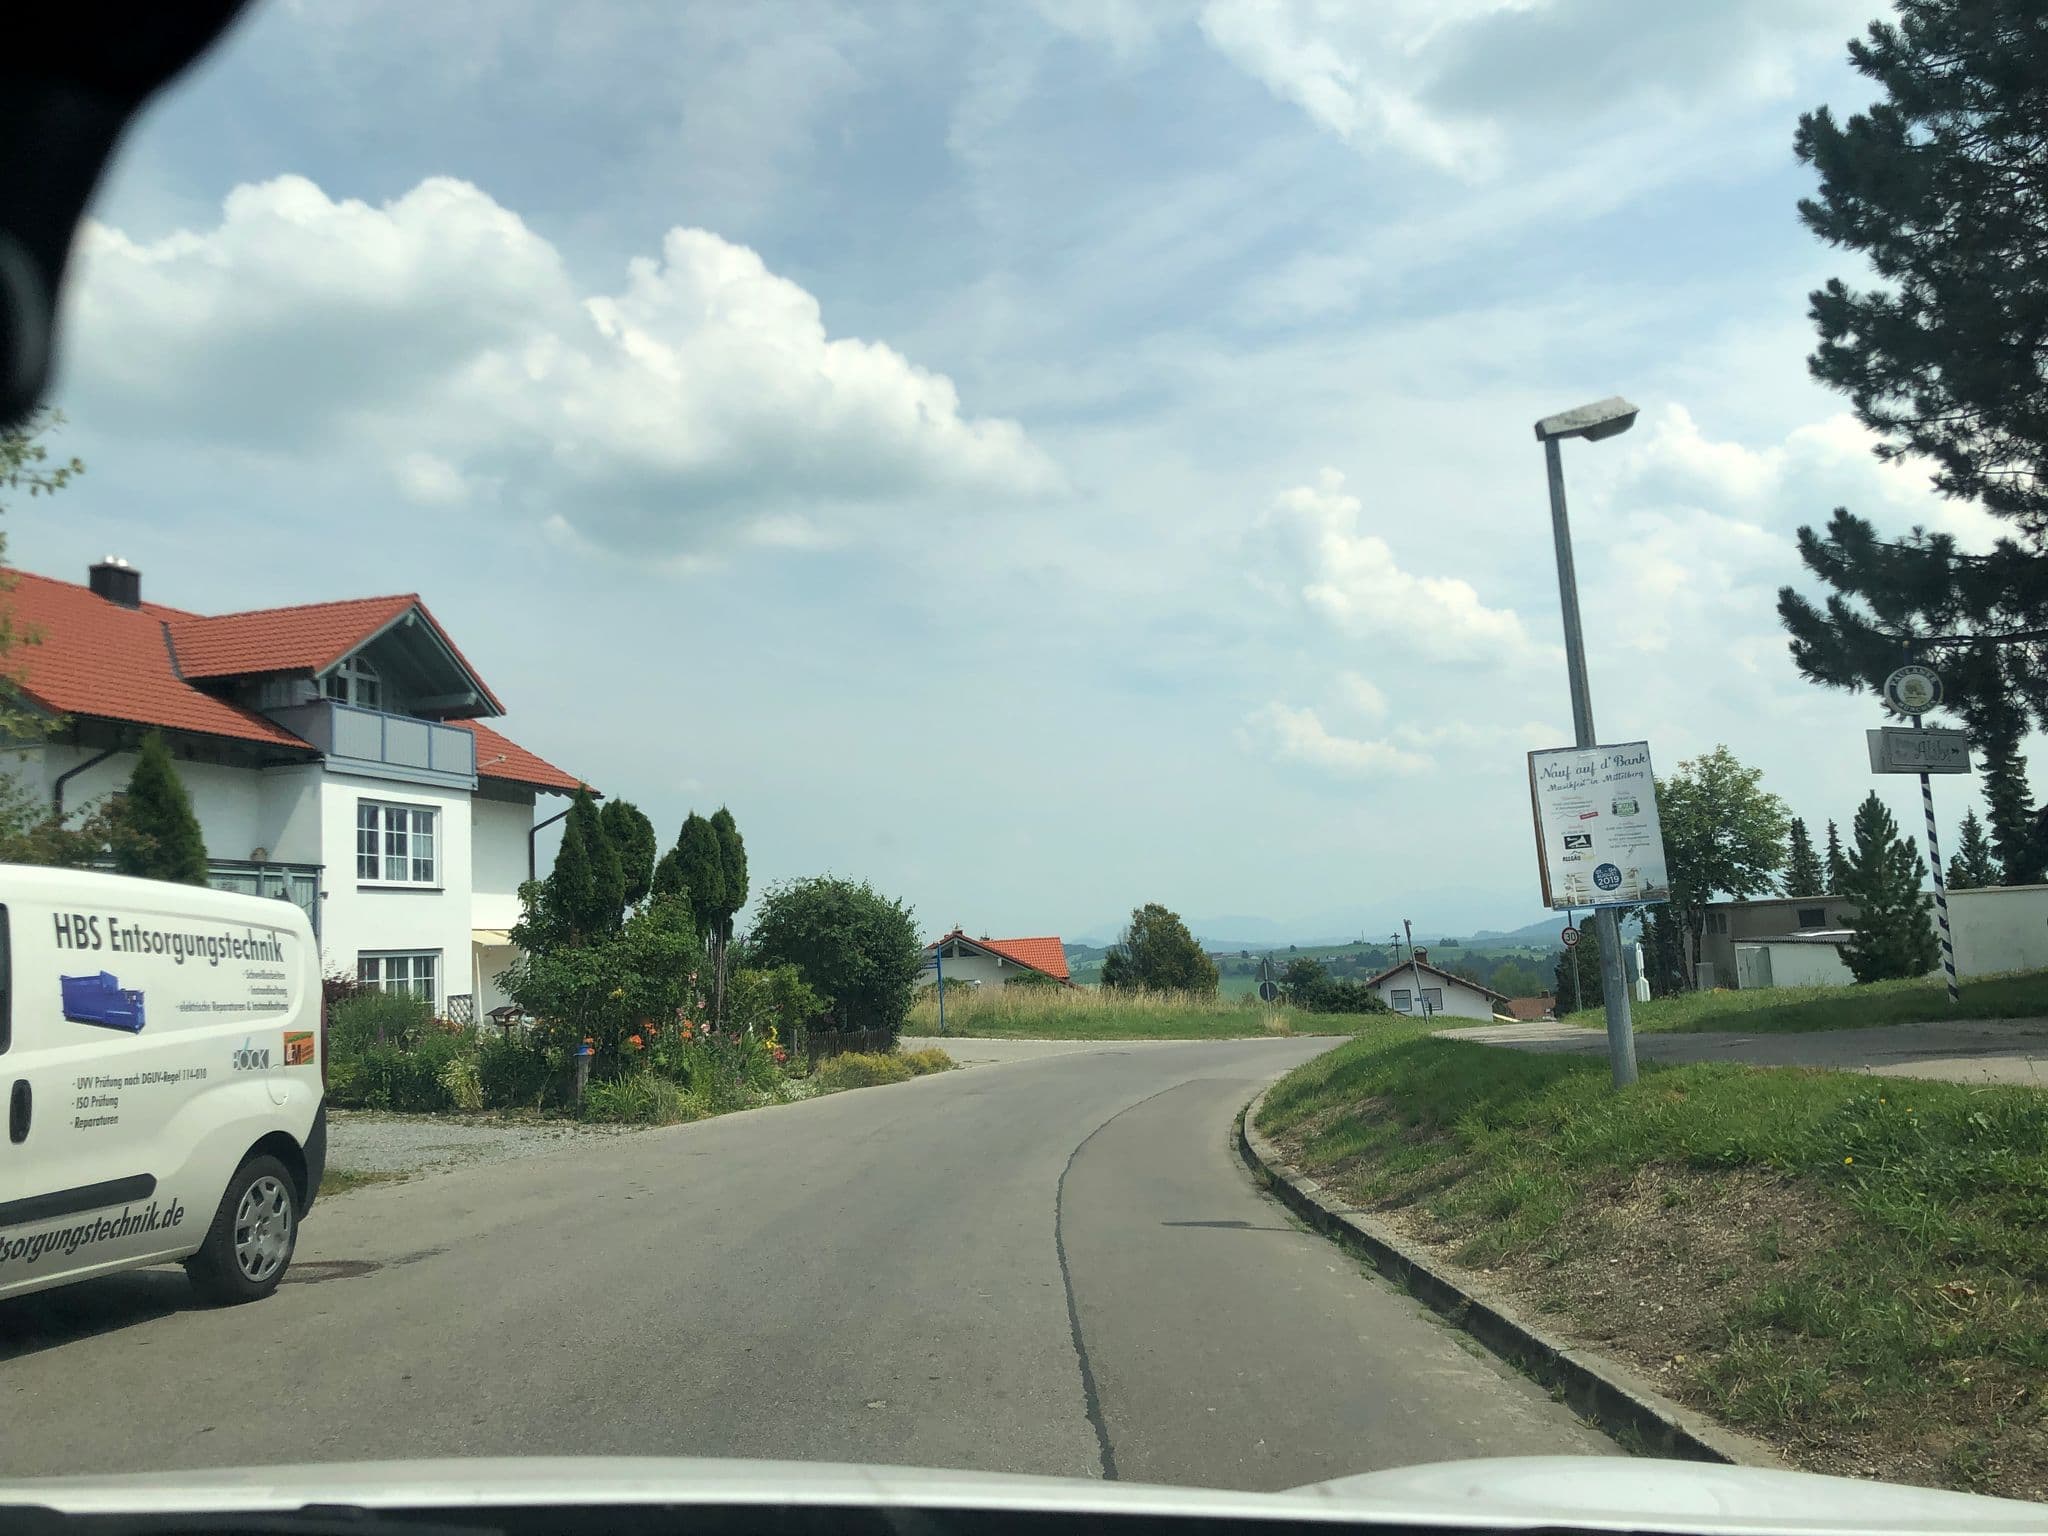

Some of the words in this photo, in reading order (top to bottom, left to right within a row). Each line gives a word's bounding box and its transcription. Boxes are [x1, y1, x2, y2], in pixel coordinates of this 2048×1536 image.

[1540, 762, 1571, 781] Nauf
[1575, 761, 1597, 776] auf
[1614, 753, 1647, 767] Bank
[1602, 771, 1644, 783] Mittelberg
[1598, 875, 1620, 886] 2019
[53, 912, 102, 950] HBS
[107, 916, 284, 967] Entsorgungstechnik
[1565, 932, 1577, 942] 30
[77, 1077, 94, 1090] UVV
[95, 1076, 123, 1089] Prüfung
[124, 1076, 140, 1086] nach
[142, 1069, 181, 1085] DGUV-Regel
[182, 1067, 207, 1081] 114-010
[76, 1096, 89, 1110] ISO
[91, 1094, 119, 1109] Prüfung
[74, 1115, 119, 1132] Reparaturen
